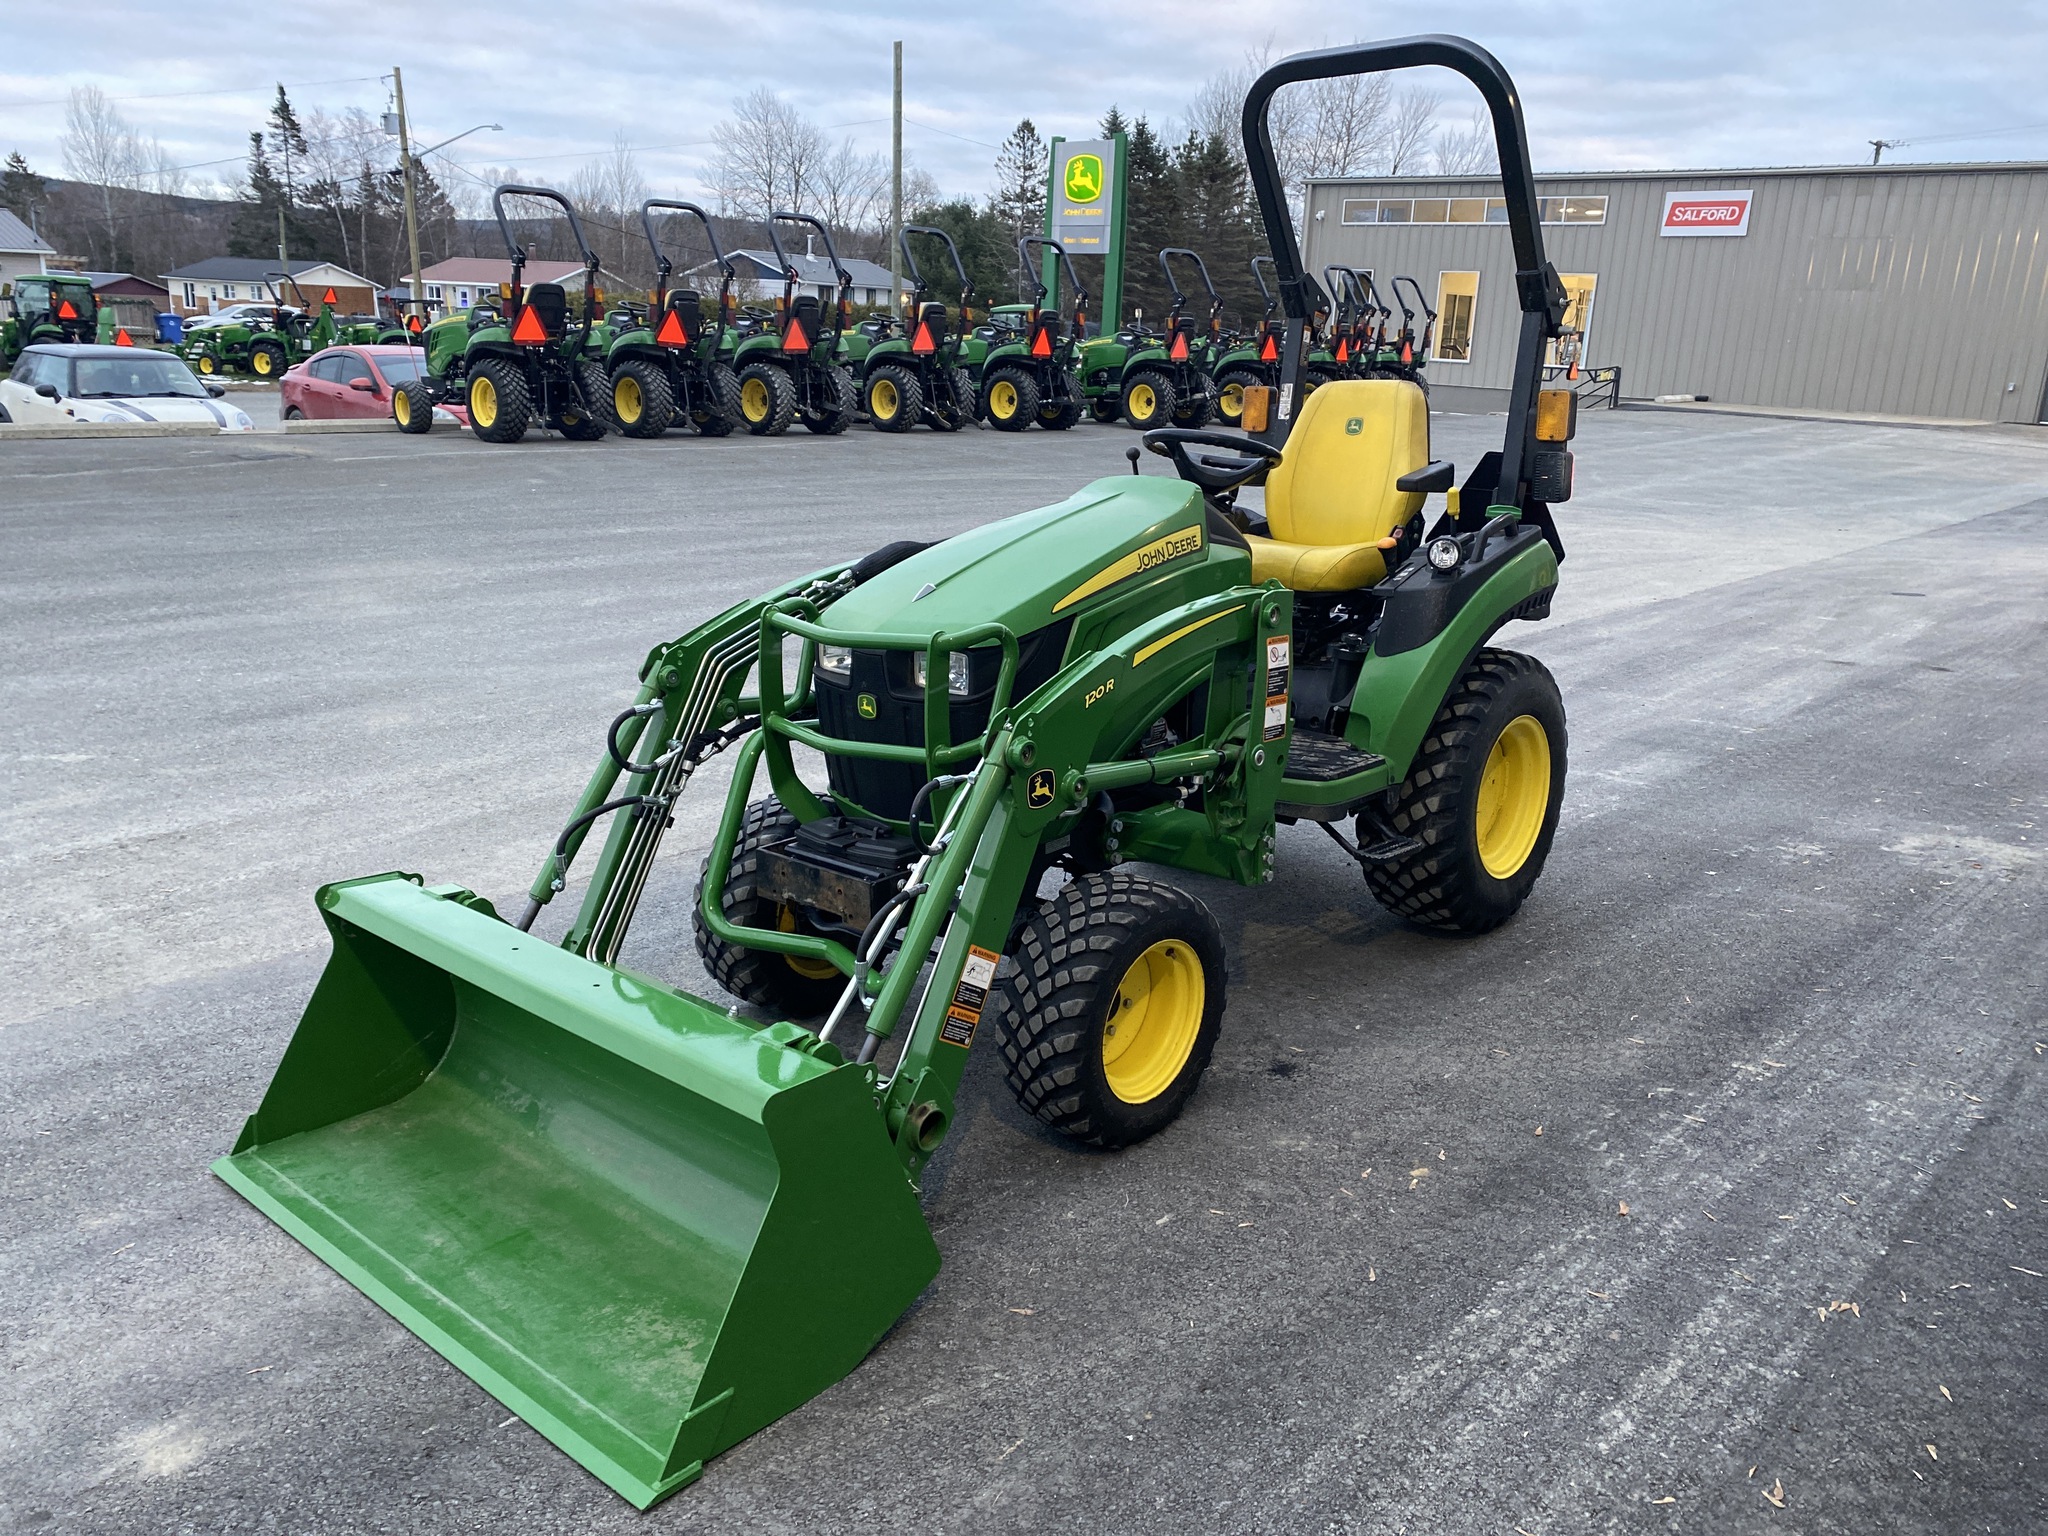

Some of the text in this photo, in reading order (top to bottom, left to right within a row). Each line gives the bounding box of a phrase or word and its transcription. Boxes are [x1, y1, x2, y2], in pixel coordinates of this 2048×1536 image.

[1672, 206, 1740, 222] SALFORD
[1136, 535, 1198, 571] JOHN DEERE
[976, 948, 997, 961] WARNING
[956, 1009, 976, 1022] WARNING
